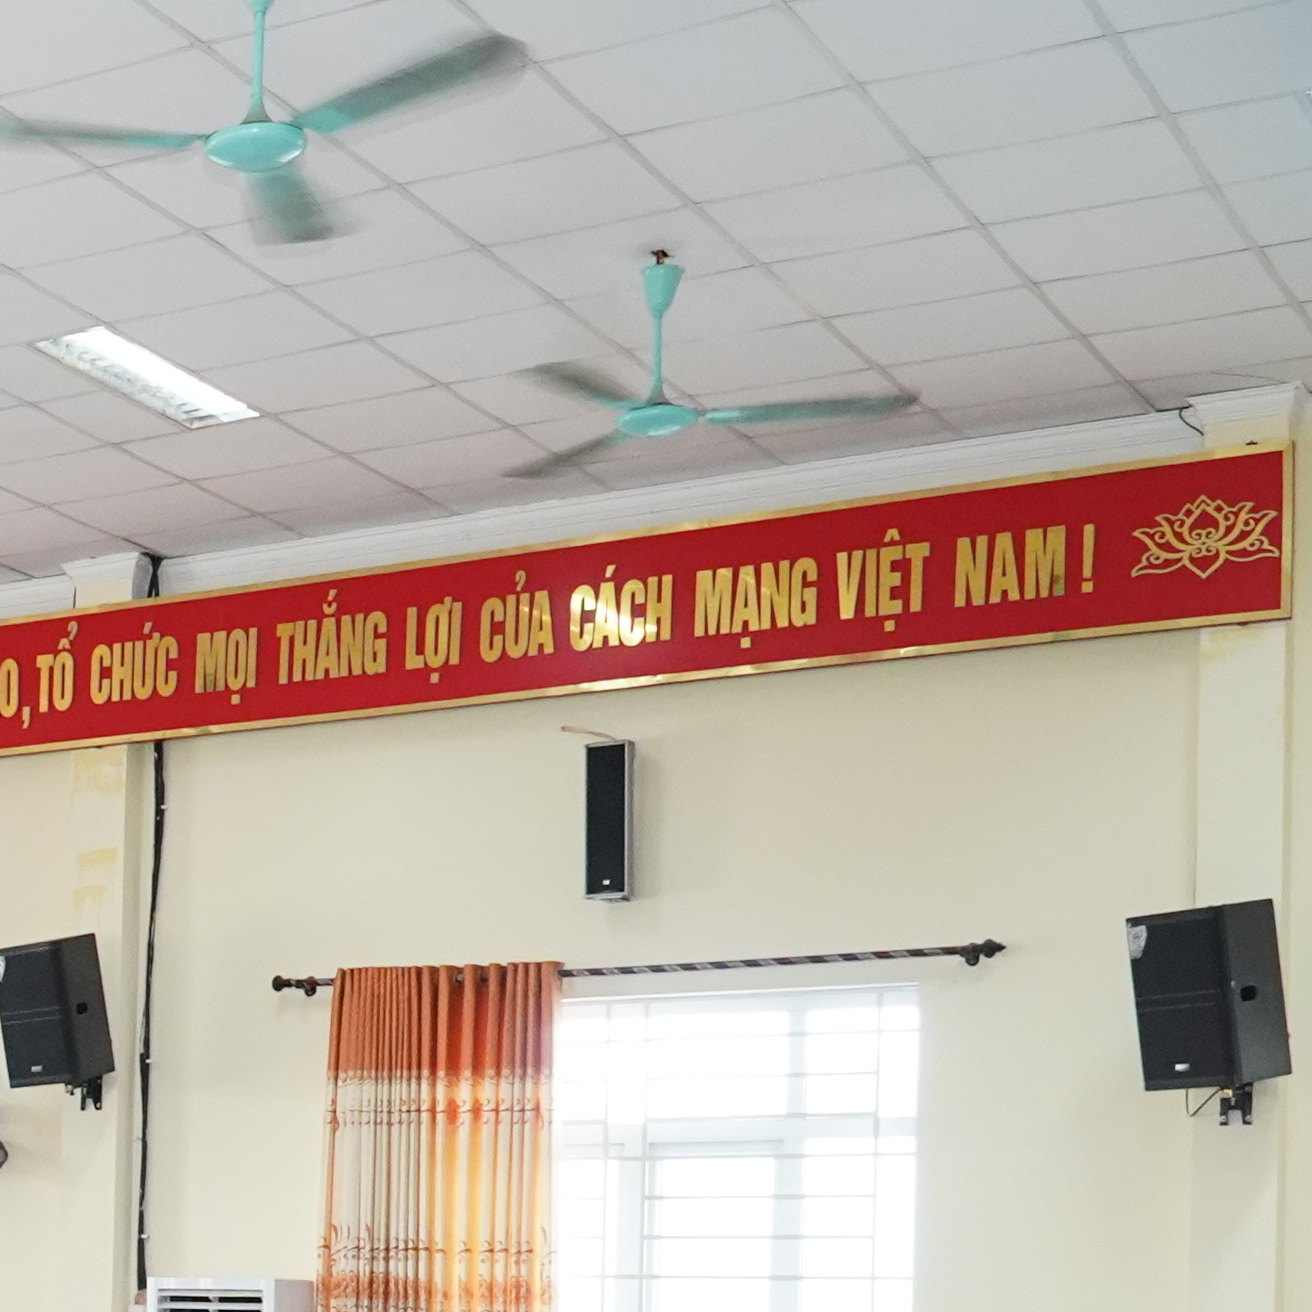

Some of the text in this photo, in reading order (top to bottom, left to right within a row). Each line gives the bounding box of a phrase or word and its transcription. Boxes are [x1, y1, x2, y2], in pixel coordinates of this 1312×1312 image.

[90, 622, 178, 704] CHỨC
[195, 627, 258, 705] MỌI
[276, 589, 387, 685] THẮNG
[405, 596, 463, 683] LỢI
[479, 570, 555, 663] CỦA
[569, 564, 674, 652] CÁCH
[694, 557, 819, 648] MẠNG
[835, 529, 931, 632] VIỆT
